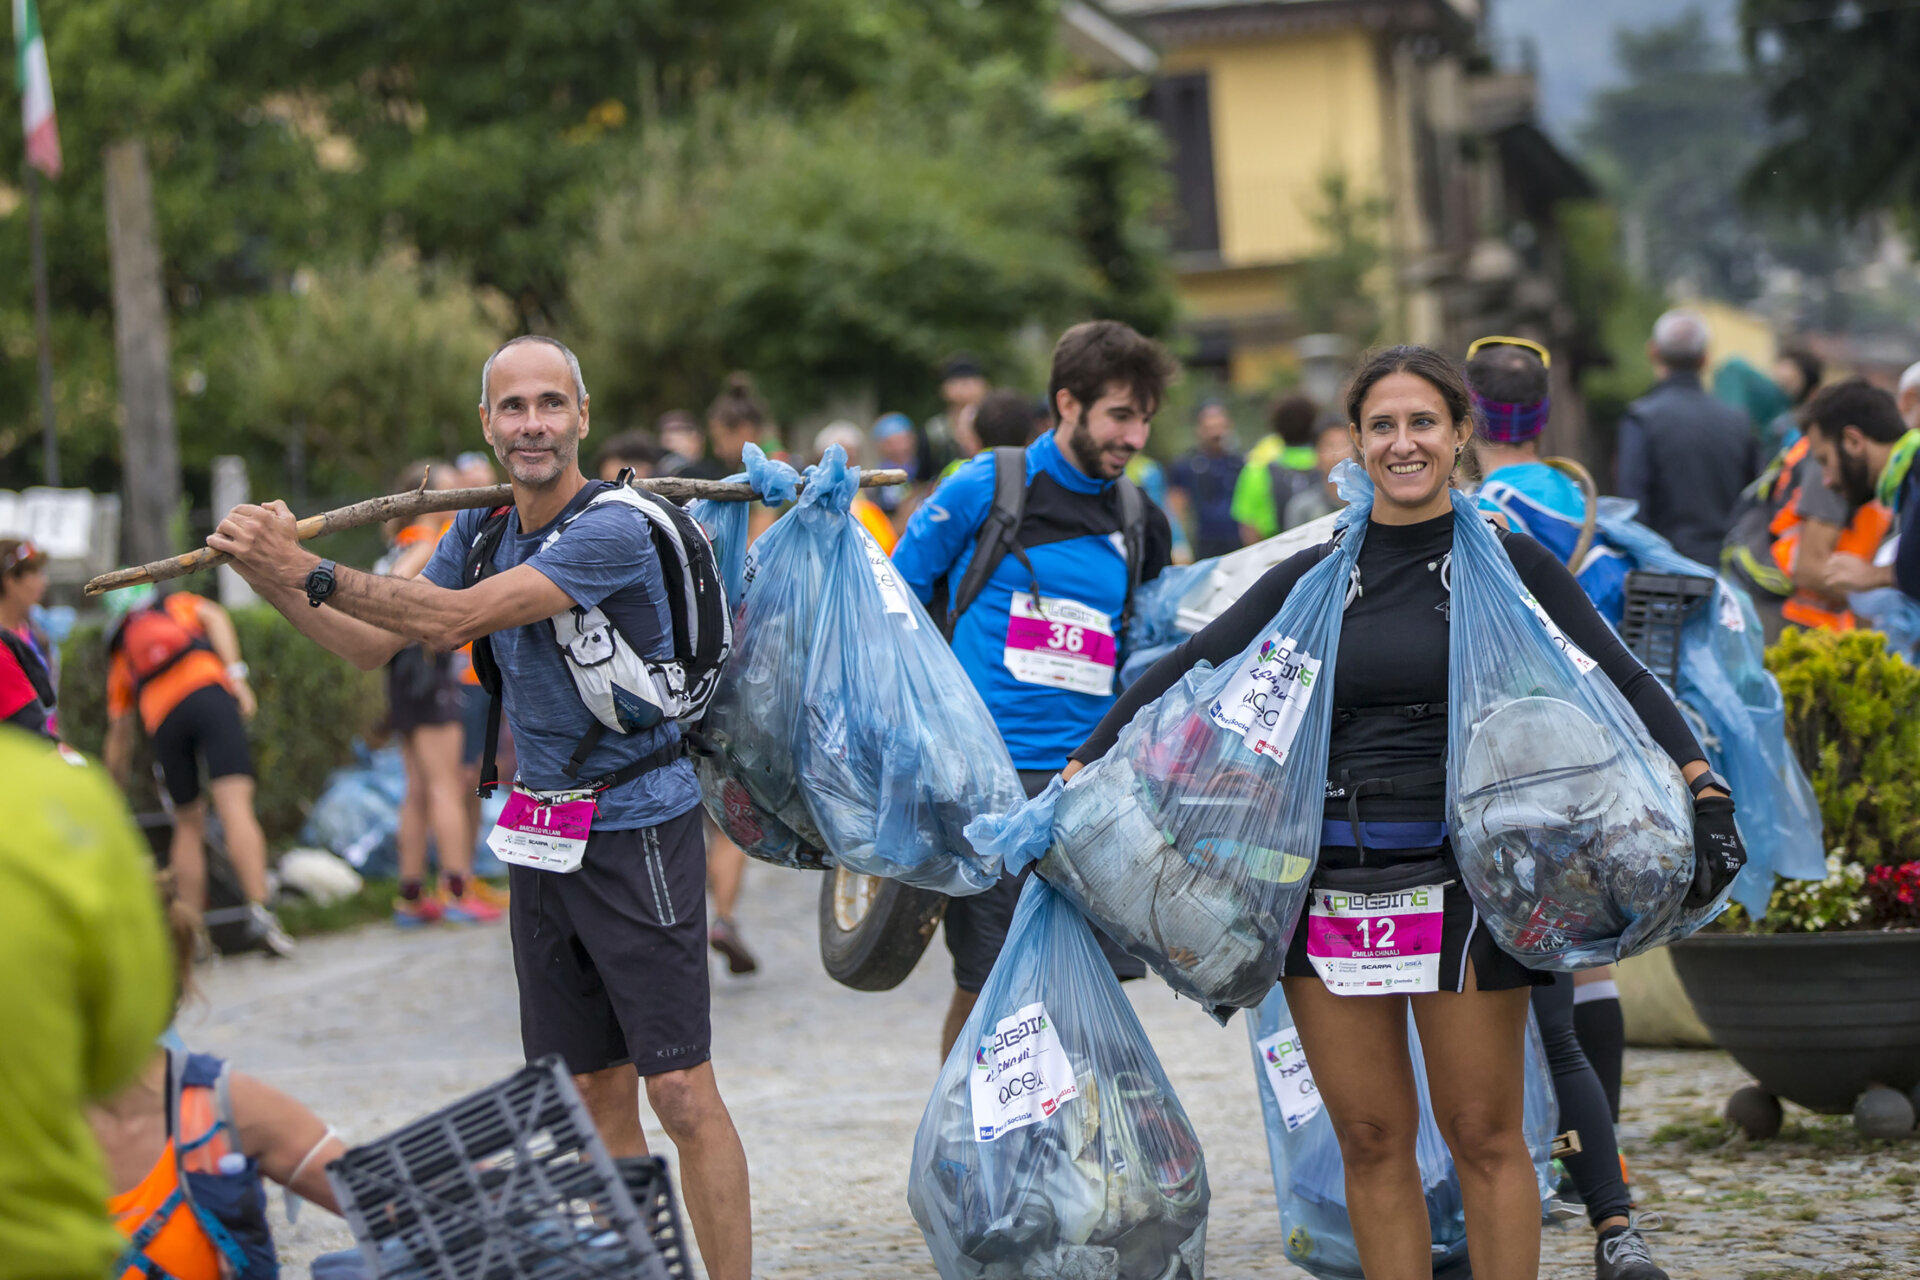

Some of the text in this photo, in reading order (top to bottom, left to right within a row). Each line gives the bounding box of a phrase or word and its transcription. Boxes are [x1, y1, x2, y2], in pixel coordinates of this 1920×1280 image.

[1047, 623, 1085, 653] 36
[1356, 917, 1396, 948] 12
[1352, 949, 1400, 958] EMILIA CHINALI
[656, 1044, 697, 1058] KIPSTA
